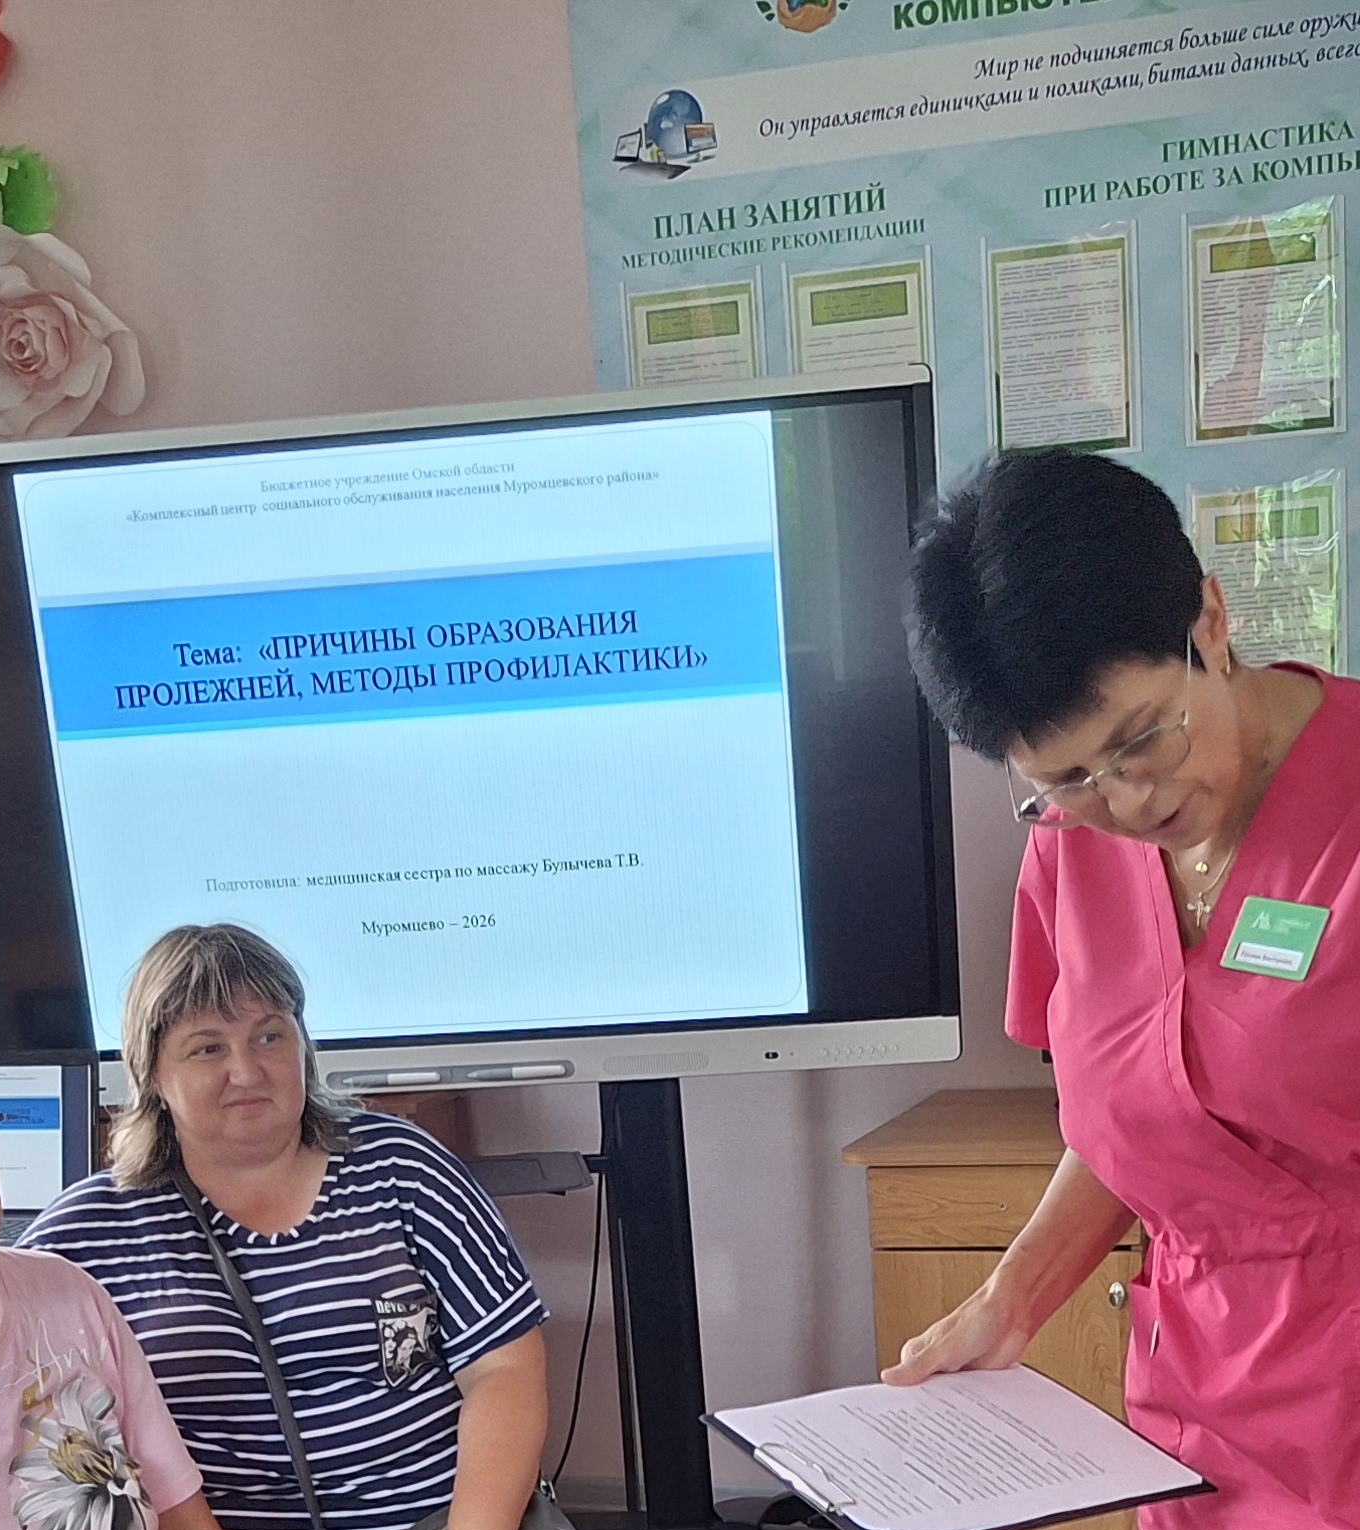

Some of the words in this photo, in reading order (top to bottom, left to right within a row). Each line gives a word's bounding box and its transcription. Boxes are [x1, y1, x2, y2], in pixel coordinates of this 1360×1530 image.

[974, 56, 1019, 81] Мир
[1022, 53, 1045, 73] не
[1049, 36, 1174, 69] подчиняется
[1179, 26, 1247, 51] больше
[1252, 20, 1295, 41] силе
[759, 117, 786, 138] Он
[787, 103, 905, 141] управляется
[910, 85, 1024, 118] единичками
[1028, 85, 1040, 101] и
[1044, 65, 1146, 99] ноликами,
[1148, 57, 1226, 86] битами
[1231, 44, 1310, 74] данных,
[1161, 119, 1355, 164] ГИМНАСТИКА
[654, 208, 737, 240] ПЛАН
[743, 182, 887, 230] ЗАНЯТИЙ
[1043, 182, 1098, 209] ПРИ
[1104, 169, 1205, 202] РАБОТЕ
[1212, 166, 1245, 189] ЗА
[621, 238, 767, 270] МЕТОДИЧЕСКИЕ
[770, 217, 926, 252] РЕКОМЕНДАЦИИ
[126, 506, 218, 522] «Комплексный
[220, 502, 256, 516] центр
[262, 496, 341, 512] социального
[343, 489, 433, 506] обслуживания
[436, 483, 500, 498] населения
[504, 474, 604, 494] Муромцевского
[607, 471, 659, 486] района»
[261, 477, 331, 493] Бюджетное
[334, 471, 409, 488] учреждение
[412, 465, 461, 480] Омской
[464, 462, 515, 476] области
[172, 640, 243, 670] Тема:
[259, 622, 417, 664] «ПРИЧИНЫ
[425, 609, 639, 651] ОБРАЗОВАНИЯ
[114, 669, 304, 711] ПРОЛЕЖНЕЙ,
[311, 660, 438, 700] МЕТОДЫ
[446, 644, 709, 689] ПРОФИЛАКТИКИ»
[205, 874, 301, 894] Подготовила:
[306, 869, 401, 888] медицинская
[403, 866, 451, 882] сестра
[454, 866, 474, 878] по
[476, 862, 539, 879] массажу
[542, 855, 612, 873] Булычева
[615, 852, 645, 869] Т.В.
[361, 916, 445, 938] Муромцево
[462, 913, 496, 929] 2026
